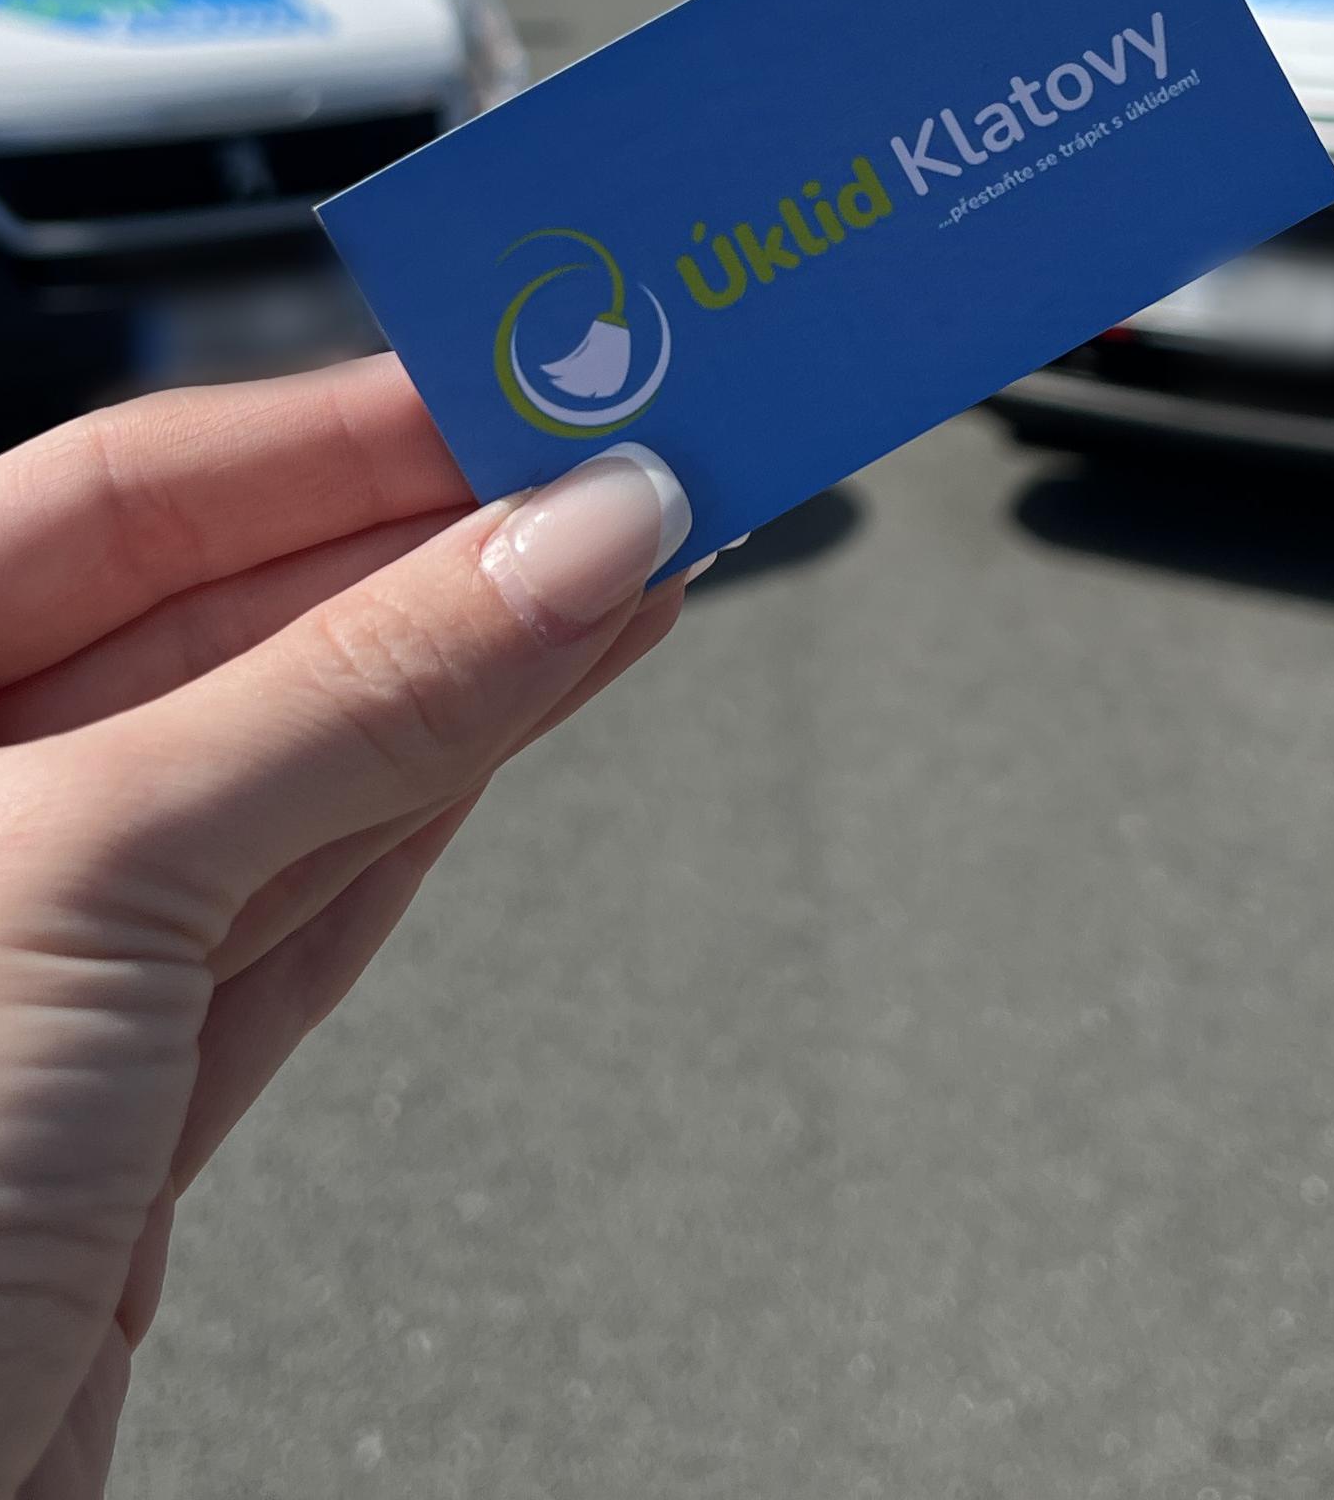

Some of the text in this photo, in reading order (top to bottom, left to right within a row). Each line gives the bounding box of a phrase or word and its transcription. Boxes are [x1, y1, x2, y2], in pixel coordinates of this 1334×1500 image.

[676, 11, 1168, 309] Úklid Klatovy
[1035, 152, 1058, 172] se
[1058, 121, 1112, 158] trápit
[1111, 115, 1124, 130] s
[1125, 68, 1201, 121] úklidem!
